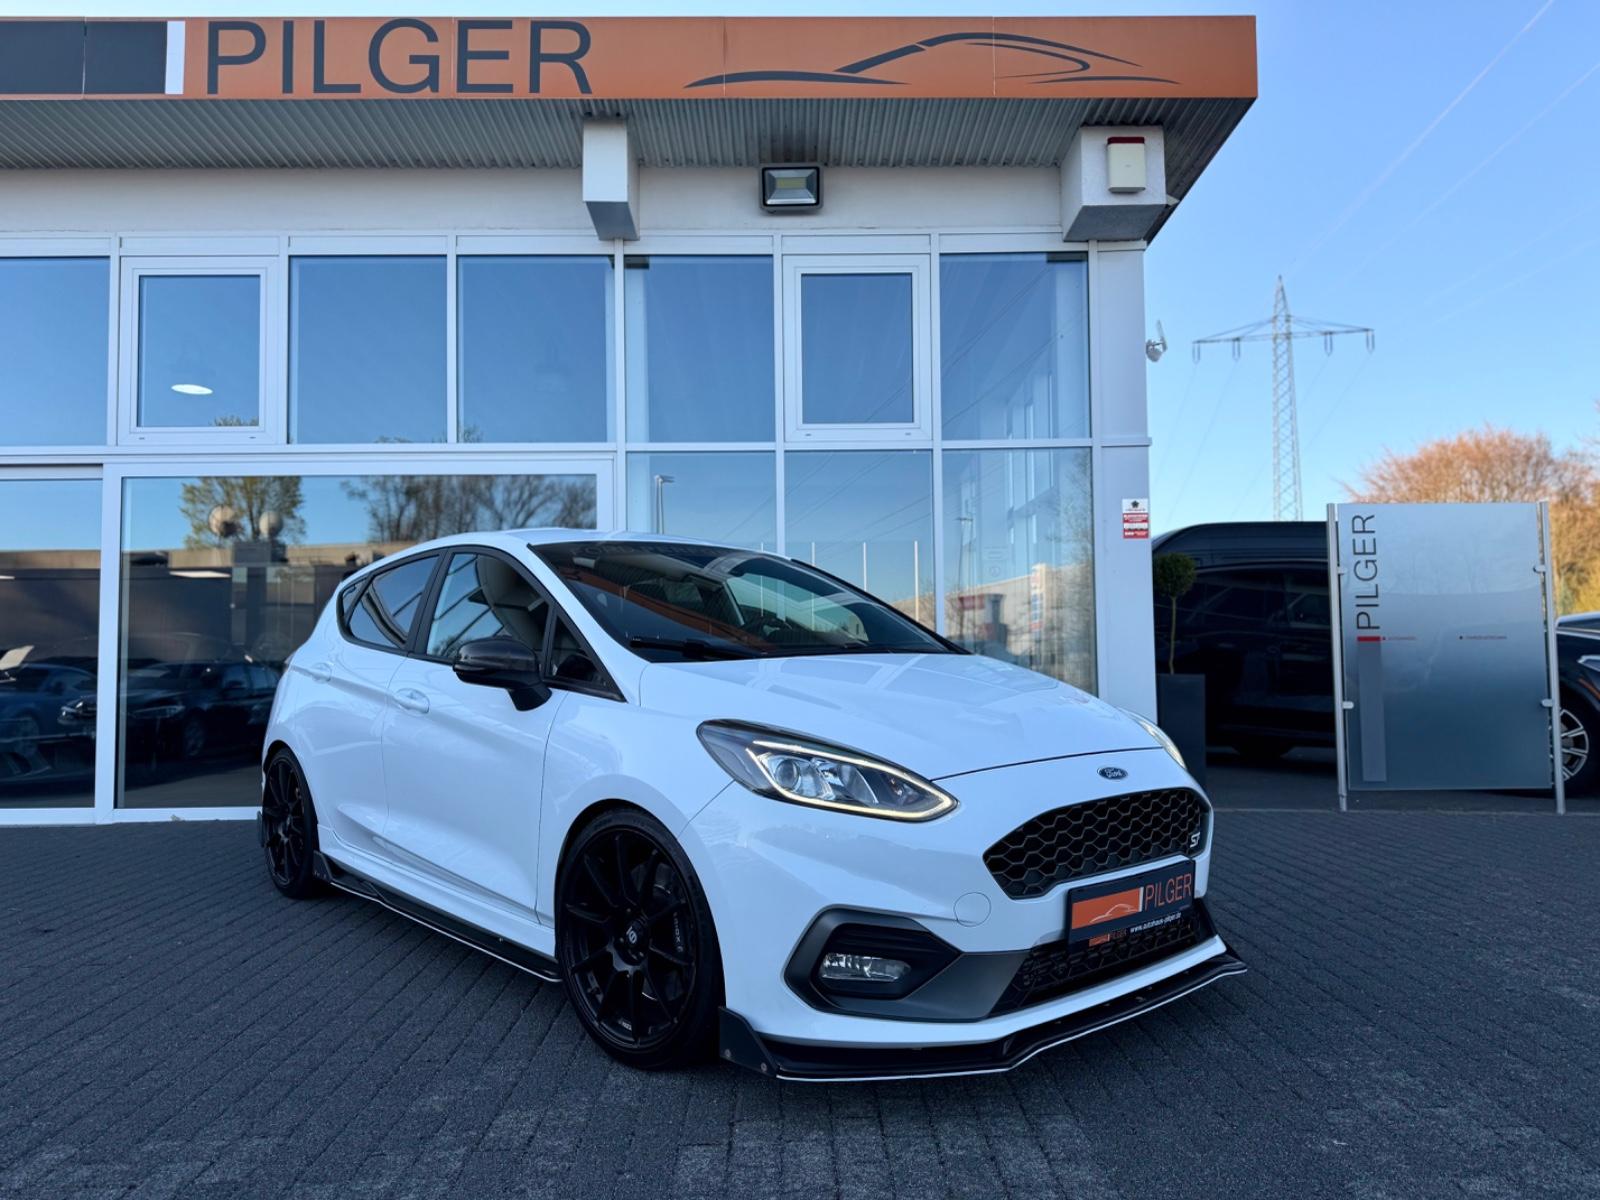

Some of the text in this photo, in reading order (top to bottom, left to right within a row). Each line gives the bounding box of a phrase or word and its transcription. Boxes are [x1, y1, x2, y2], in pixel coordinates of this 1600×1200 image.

[207, 18, 592, 95] PILGER
[1352, 515, 1380, 629] PILGER
[1145, 873, 1192, 911] PILGER
